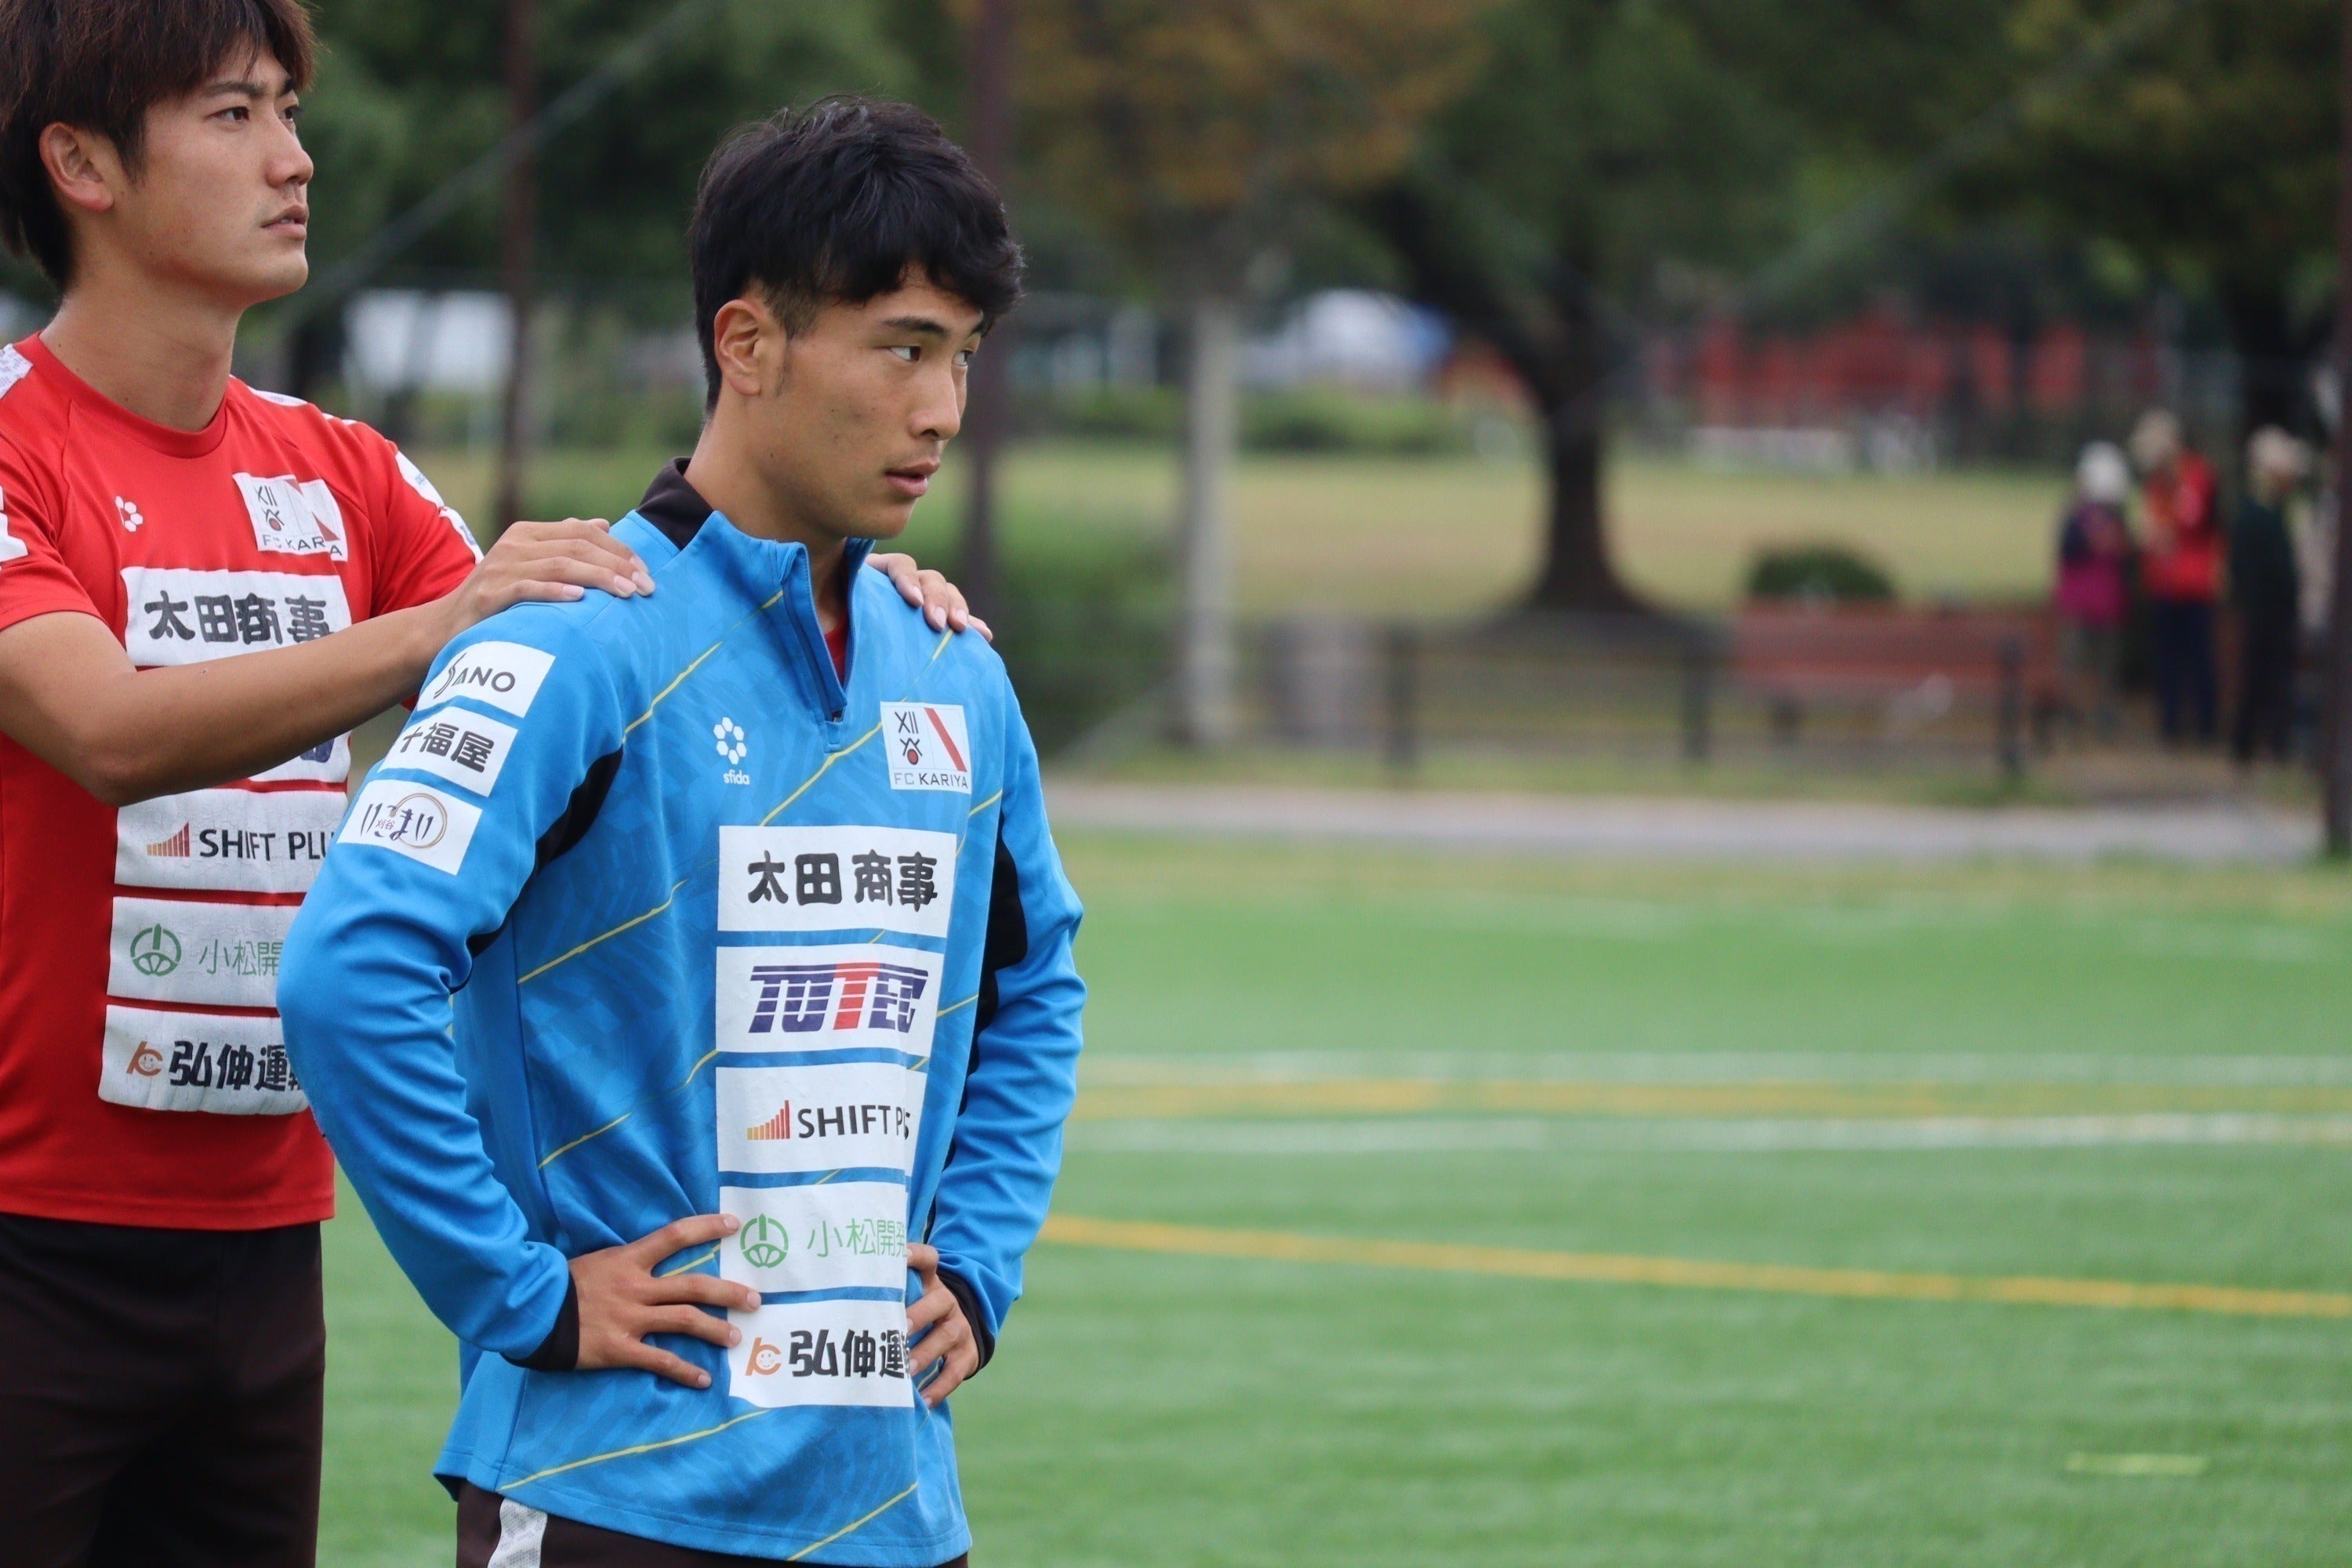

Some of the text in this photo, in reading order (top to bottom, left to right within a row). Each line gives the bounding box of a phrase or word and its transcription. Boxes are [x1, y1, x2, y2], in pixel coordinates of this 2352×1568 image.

[144, 590, 335, 643] 太田商事
[434, 652, 515, 699] SANO
[895, 711, 919, 734] XII
[400, 722, 494, 773] 十福屋
[723, 769, 750, 785] sfida
[894, 773, 968, 789] FC KARIYA
[199, 829, 275, 861] SHIFT
[748, 849, 938, 913] 太田商事
[169, 1040, 302, 1091] 弘伸運
[797, 1105, 891, 1138] SHIFT
[789, 1329, 909, 1380] 弘伸運
